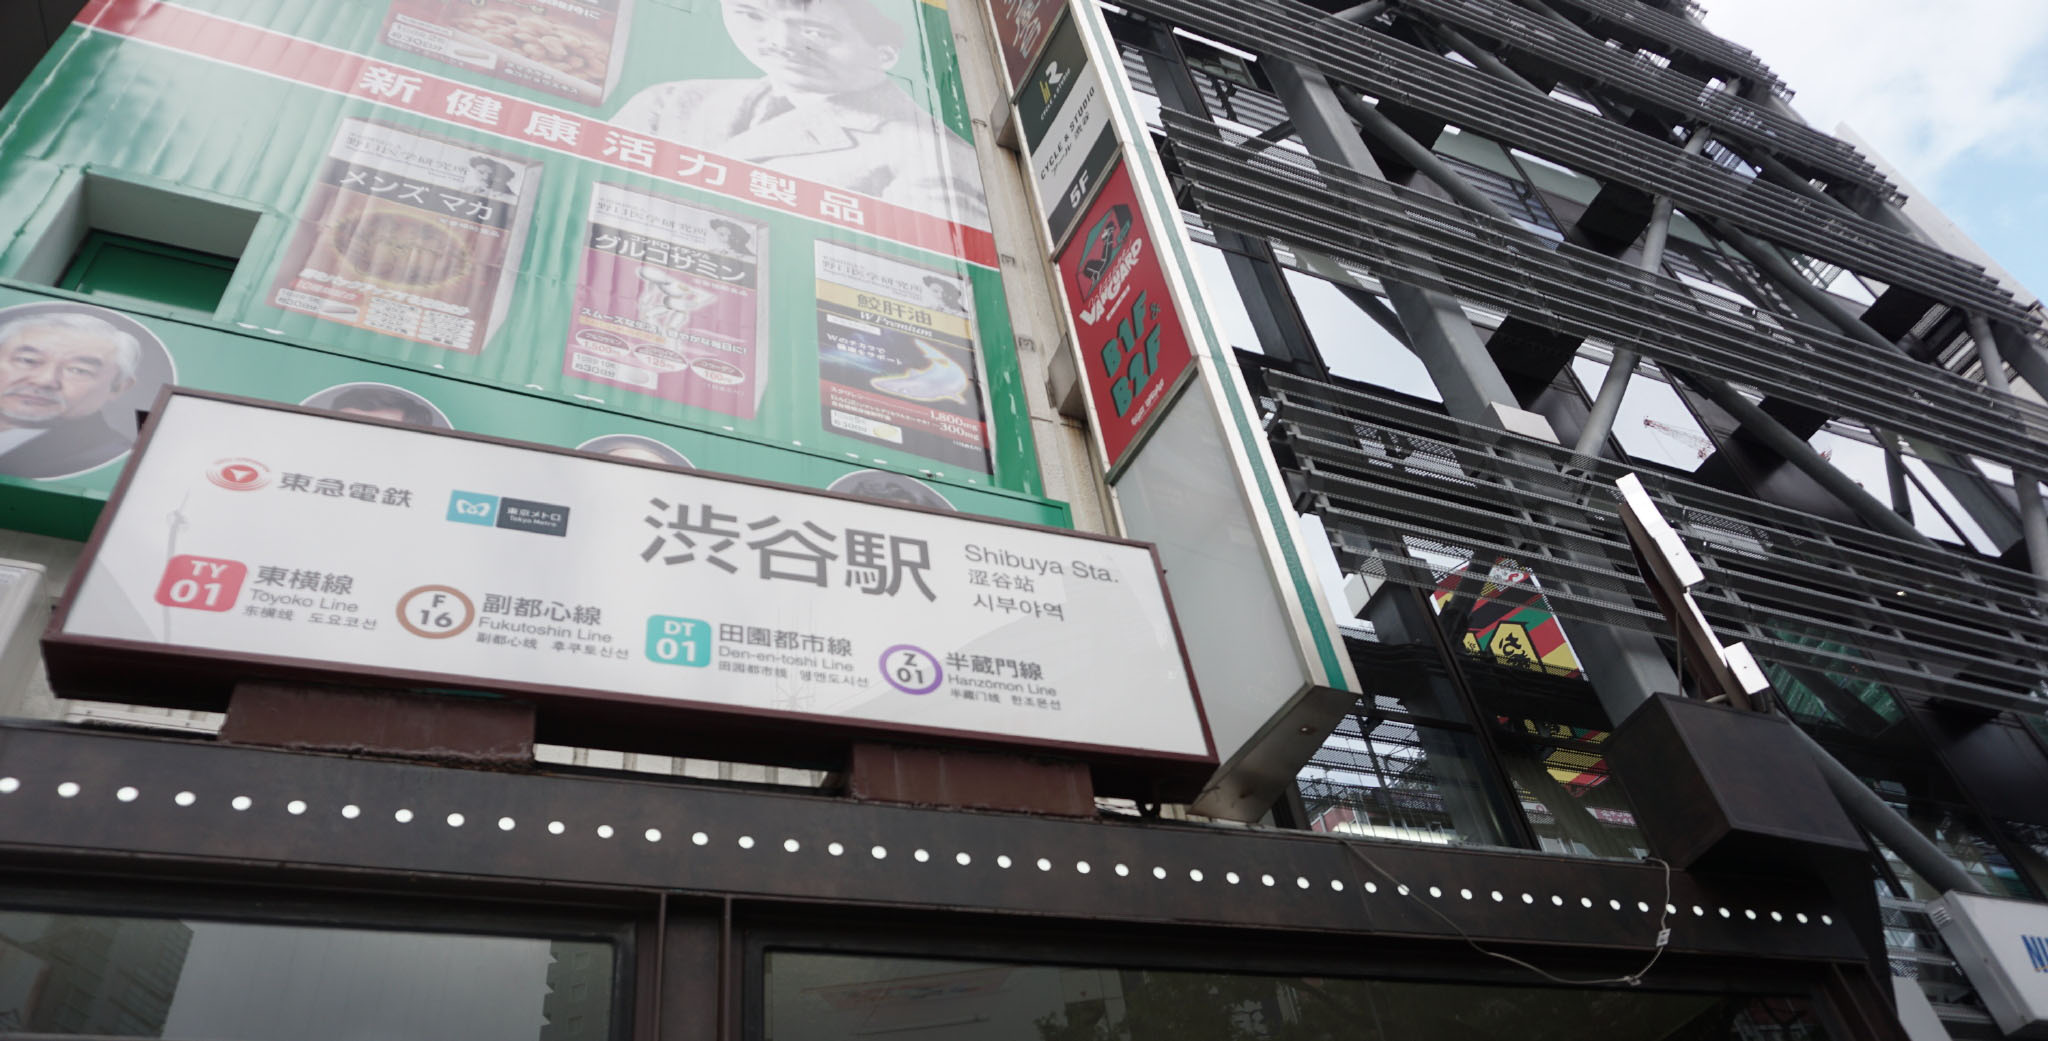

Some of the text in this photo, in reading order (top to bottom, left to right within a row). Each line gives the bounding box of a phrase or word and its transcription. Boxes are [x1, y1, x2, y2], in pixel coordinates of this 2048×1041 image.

[359, 66, 865, 227] 新健康活力製品
[1040, 146, 1063, 180] CYCLE
[1069, 86, 1095, 132] STUDIO
[340, 171, 430, 204] メンズ
[439, 193, 493, 221] マカ
[1069, 170, 1089, 208] 5F
[595, 234, 746, 281] グルコサミン
[1079, 237, 1143, 326] VANGUARD
[857, 293, 933, 326] 鮫肝油
[871, 313, 933, 338] Premium
[1101, 289, 1147, 378] B1F
[1110, 323, 1161, 418] B2F
[277, 471, 415, 508] 東急電鉄
[506, 505, 562, 522] 東京メトロ
[508, 515, 557, 528] Tokyo Metro
[640, 497, 938, 602] 渋谷駅
[964, 543, 1119, 583] Shibuya Sta.
[190, 560, 229, 579] TY
[254, 564, 354, 596] 東横線
[169, 578, 224, 607] 01
[250, 588, 359, 614] Toyoko Line
[431, 594, 447, 608] F
[307, 612, 378, 631] 도요코선
[419, 609, 453, 628] 16
[482, 592, 602, 626] 副都心線
[973, 593, 1065, 622] 시부야역
[478, 616, 612, 644] Fukutoshin Line
[663, 620, 696, 637] DT
[719, 622, 853, 657] 田園都市線
[655, 638, 698, 662] 01
[718, 645, 854, 672] Den-en-toshi Line
[903, 652, 918, 667] Z
[896, 668, 924, 685] 01
[945, 651, 1045, 681] 半蔵門線
[1027, 684, 1057, 698] Line
